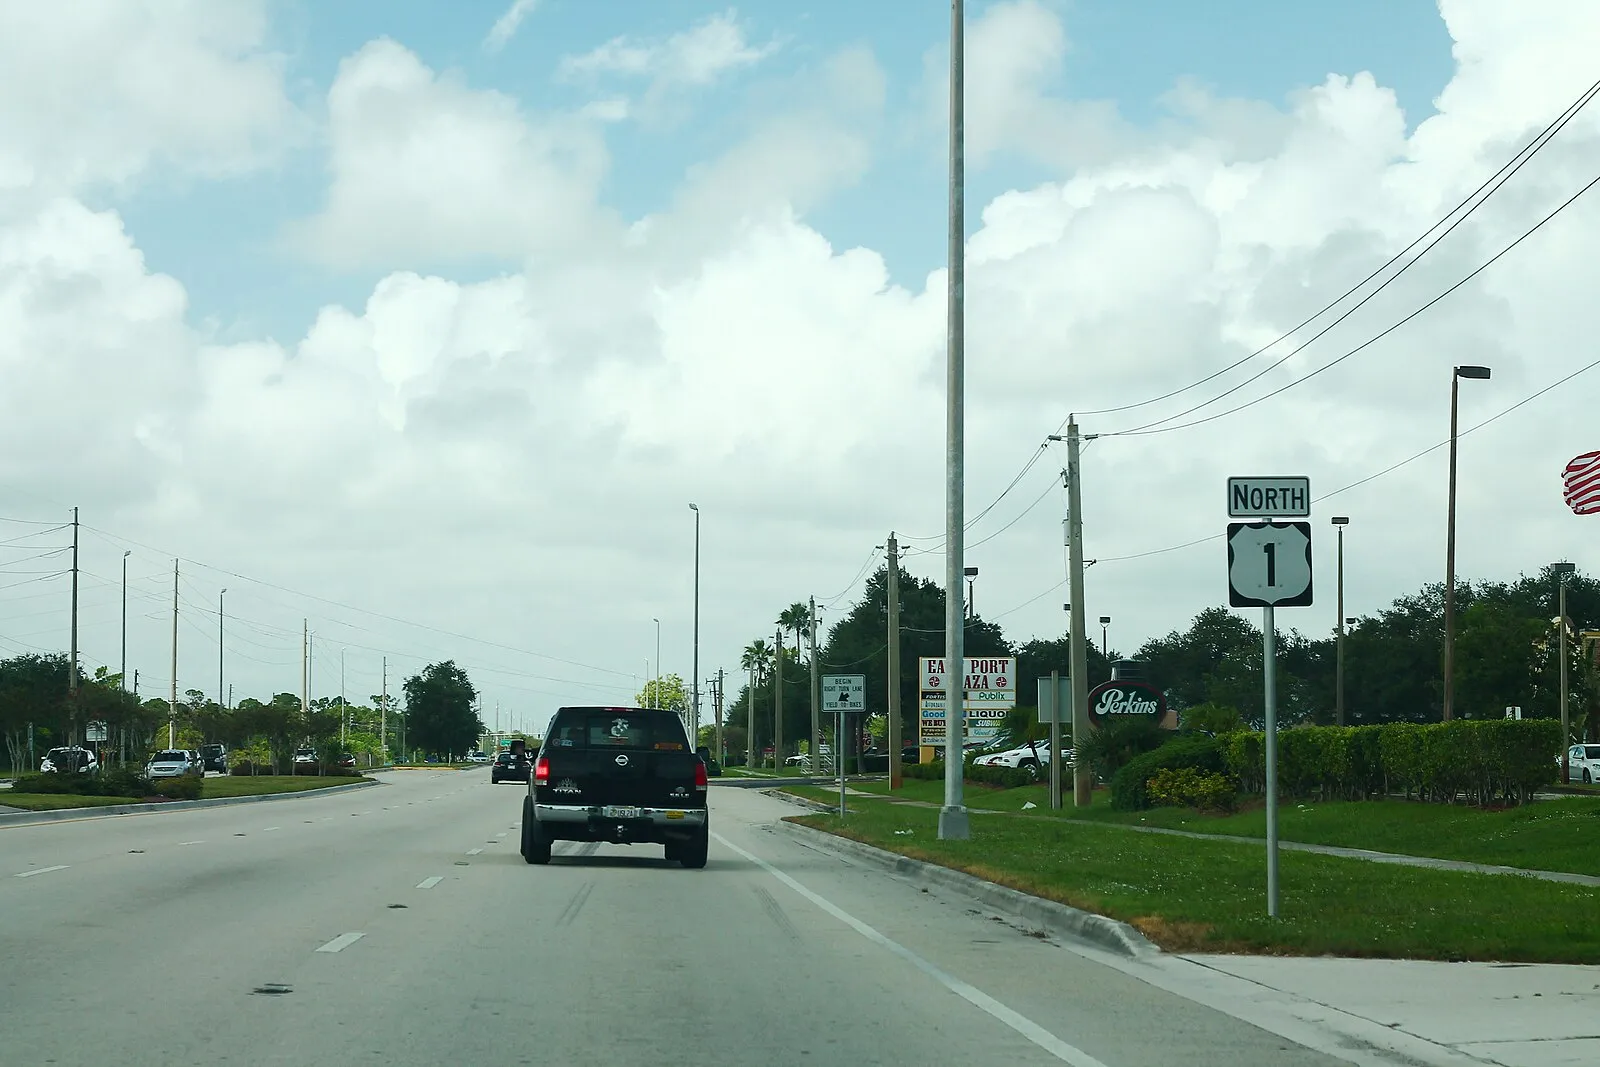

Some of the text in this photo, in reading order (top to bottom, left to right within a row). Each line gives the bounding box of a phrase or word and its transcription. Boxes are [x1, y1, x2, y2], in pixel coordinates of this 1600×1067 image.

[1233, 484, 1304, 510] NORTH
[1263, 542, 1276, 587] 1
[970, 659, 1009, 674] PORT
[963, 675, 989, 689] AZA
[978, 691, 1005, 700] Publix
[1094, 688, 1158, 715] Perkins
[921, 719, 933, 727] WE
[975, 719, 1001, 727] SUBWA
